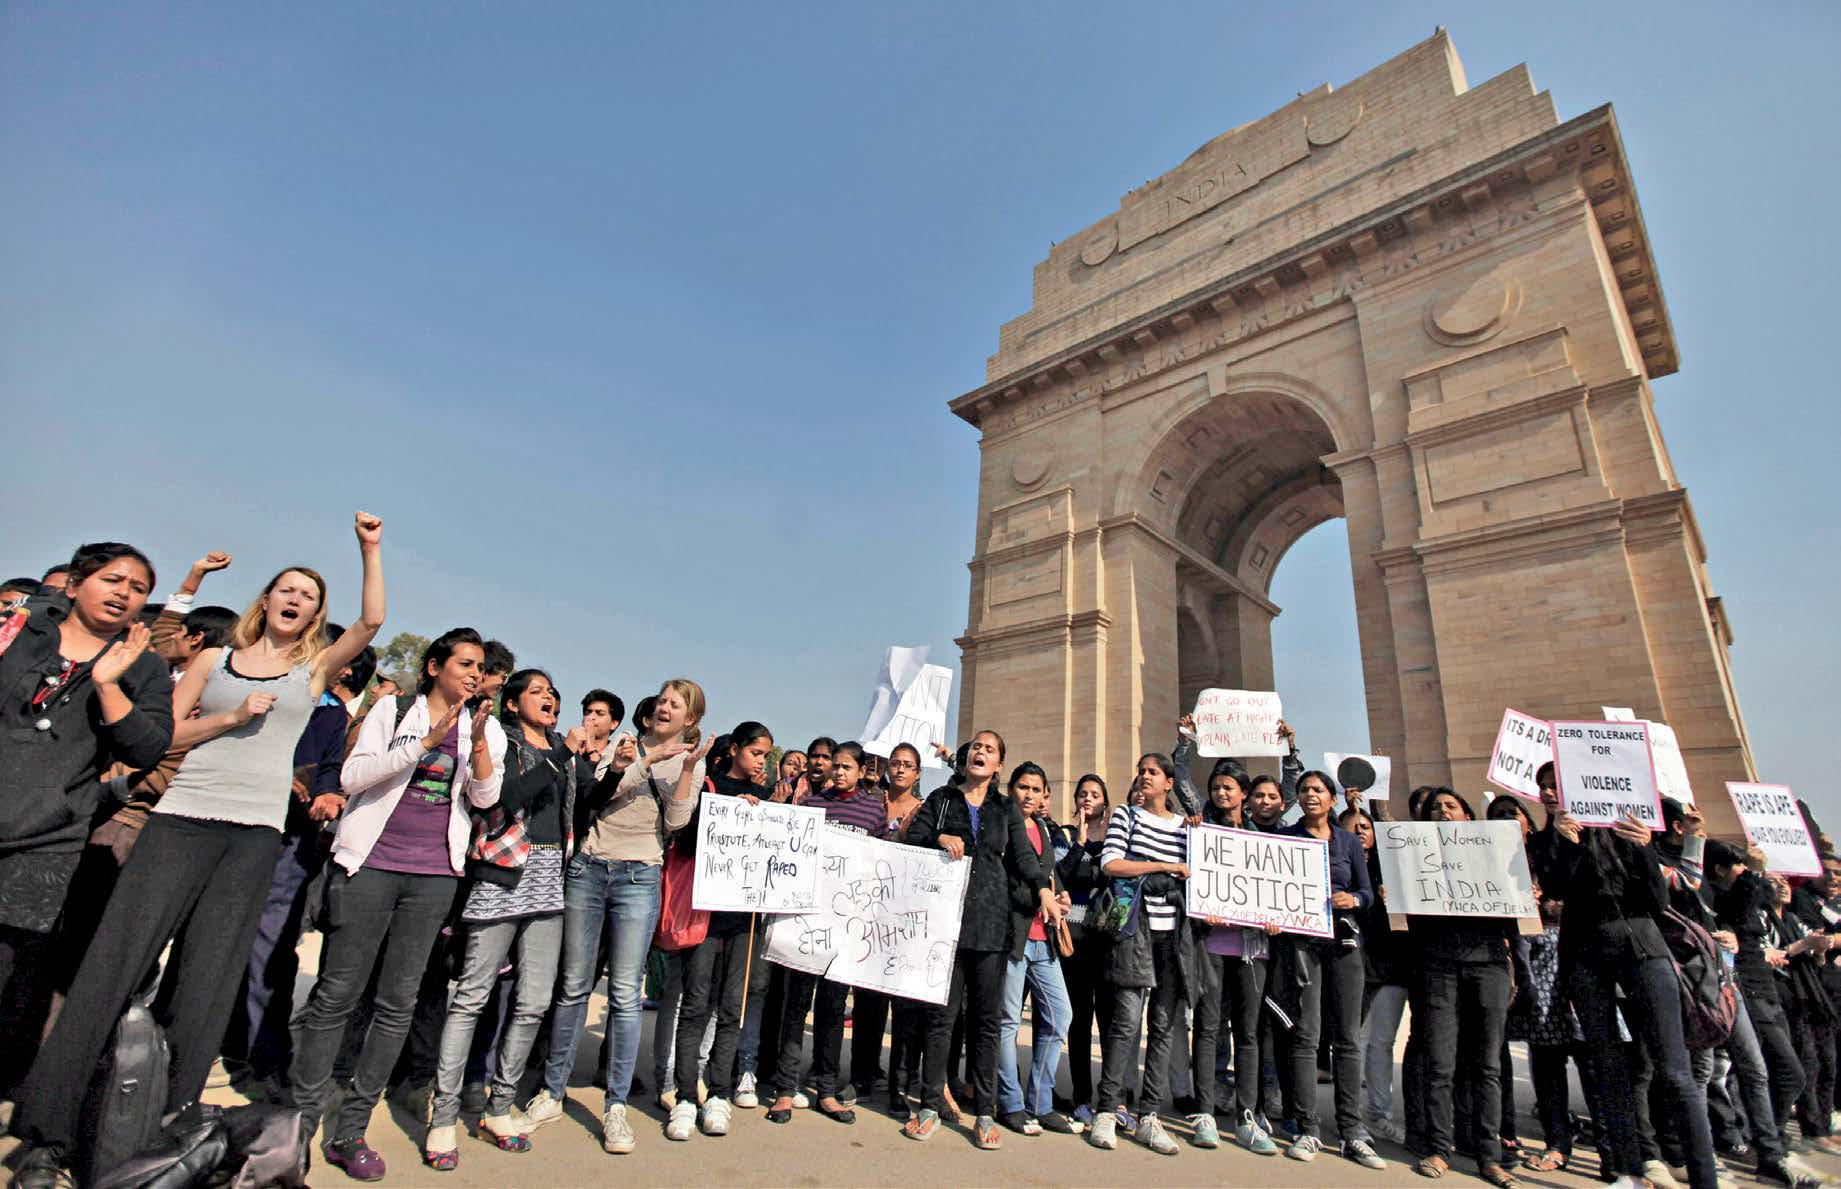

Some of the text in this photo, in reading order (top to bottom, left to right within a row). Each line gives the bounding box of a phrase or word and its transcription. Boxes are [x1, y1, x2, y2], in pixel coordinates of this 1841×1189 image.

[1165, 163, 1247, 217] INDIA
[1197, 712, 1221, 725] LATE
[1227, 711, 1240, 723] AT
[1506, 718, 1525, 736] ITS
[1525, 726, 1534, 741] A
[1557, 728, 1645, 741] ZERO TOLERANCE
[1591, 745, 1611, 755] FOR
[1497, 751, 1533, 781] NOT A
[1581, 775, 1632, 792] VIOLENCE
[1570, 801, 1655, 820] AGAINST WOMEN
[1735, 792, 1765, 815] RAPE
[789, 836, 801, 853] U
[1385, 825, 1492, 850] SAVE WOMEN
[1203, 833, 1311, 877] WE WANT
[1419, 853, 1464, 874] SAVE
[764, 854, 798, 890] RAPED
[1197, 868, 1320, 916] JUSTICE
[1415, 878, 1503, 902] INDIA
[1482, 902, 1501, 913] OF
[796, 914, 832, 956] होना
